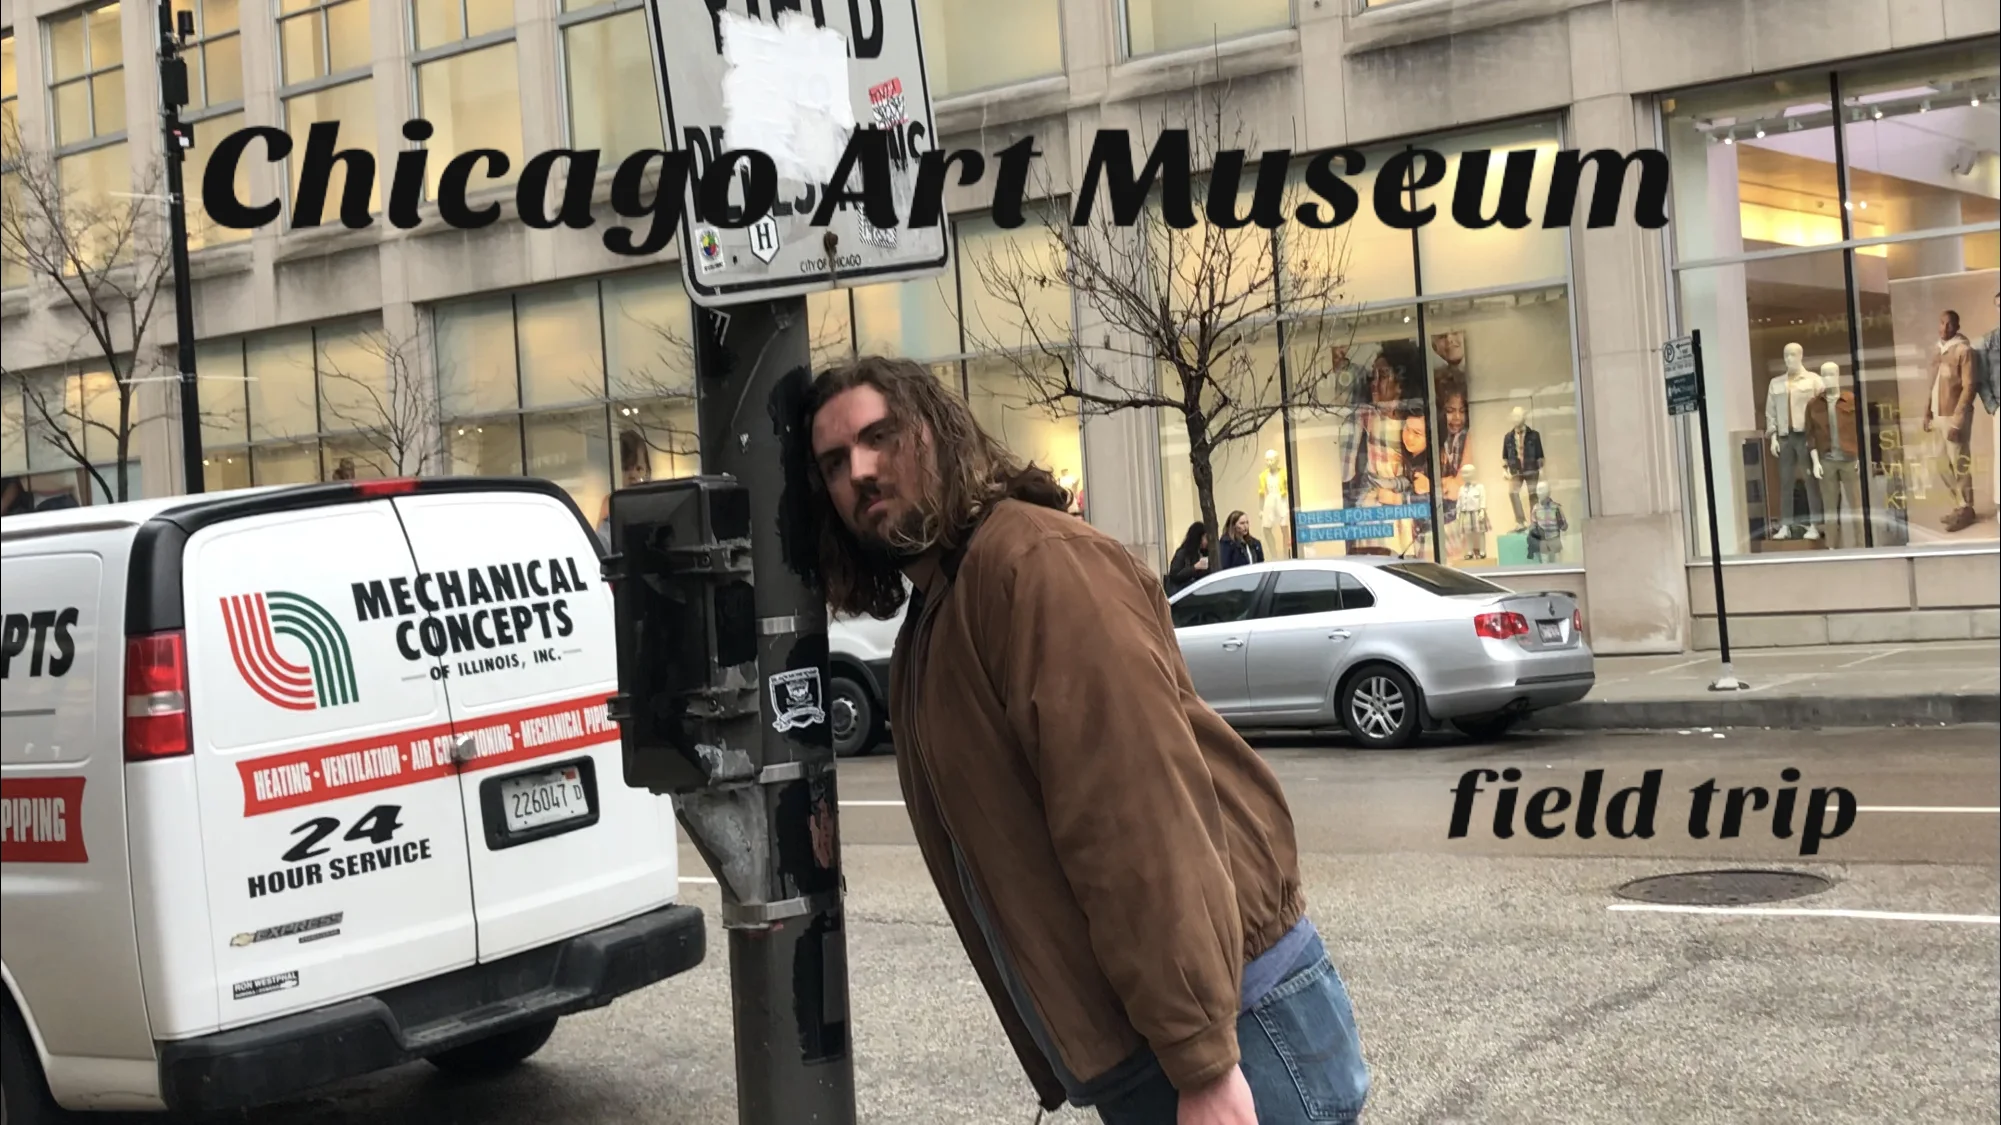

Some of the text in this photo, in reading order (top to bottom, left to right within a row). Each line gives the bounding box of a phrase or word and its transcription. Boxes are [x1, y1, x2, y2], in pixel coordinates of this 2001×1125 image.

[756, 223, 772, 250] H
[800, 258, 815, 273] CITY
[1297, 504, 1428, 525] DRESS FOR SPRING
[1310, 525, 1393, 541] EVERYTHING
[351, 557, 588, 621] MECHANICAL
[1, 607, 80, 679] PTS
[396, 599, 573, 661] CONCEPTS
[430, 648, 562, 681] OF ILLINOIS, INC.
[253, 761, 312, 801] HEATING
[321, 744, 401, 788] VENTILATION
[410, 739, 433, 771] AIR
[520, 710, 584, 748] MECHANICAL
[1, 797, 67, 843] PIPING
[512, 783, 582, 818] 226047 D
[281, 805, 404, 862] 24
[247, 838, 432, 898] HOUR SERVICE
[255, 913, 342, 942] EXPRESS
